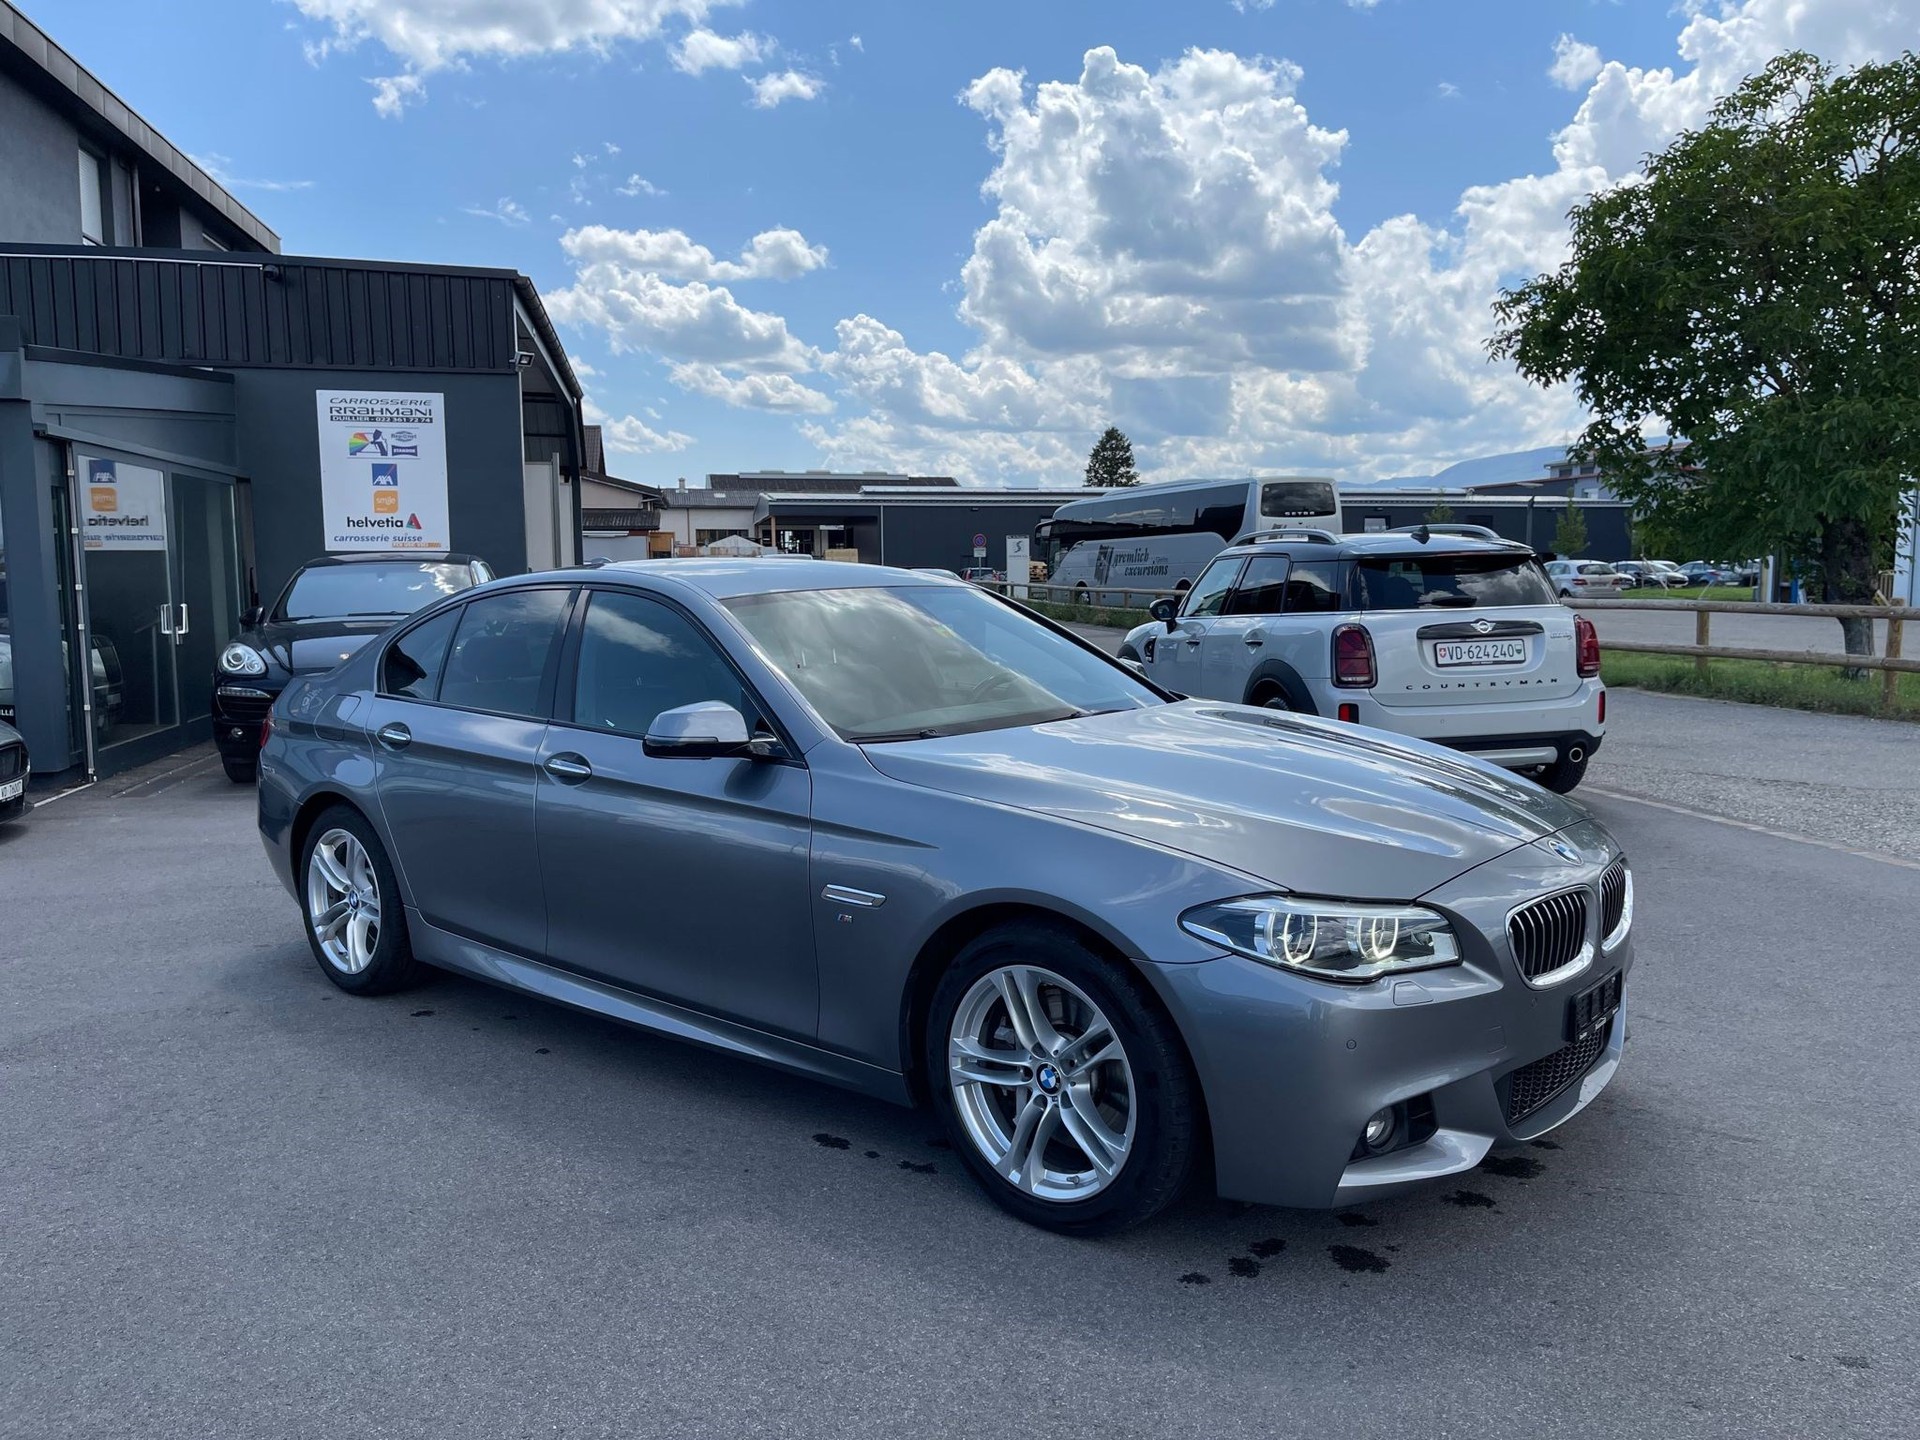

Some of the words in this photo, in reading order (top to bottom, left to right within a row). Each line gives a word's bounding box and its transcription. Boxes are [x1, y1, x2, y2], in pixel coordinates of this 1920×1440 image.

[330, 397, 432, 406] CARROSSERIE
[374, 475, 394, 485] AXA
[347, 517, 404, 528] helvetia
[334, 534, 390, 542] carrosserie
[392, 533, 423, 542] suisse
[1112, 547, 1149, 568] gremlich
[1124, 560, 1169, 576] excursions
[1405, 678, 1558, 690] COUNTRYMAN
